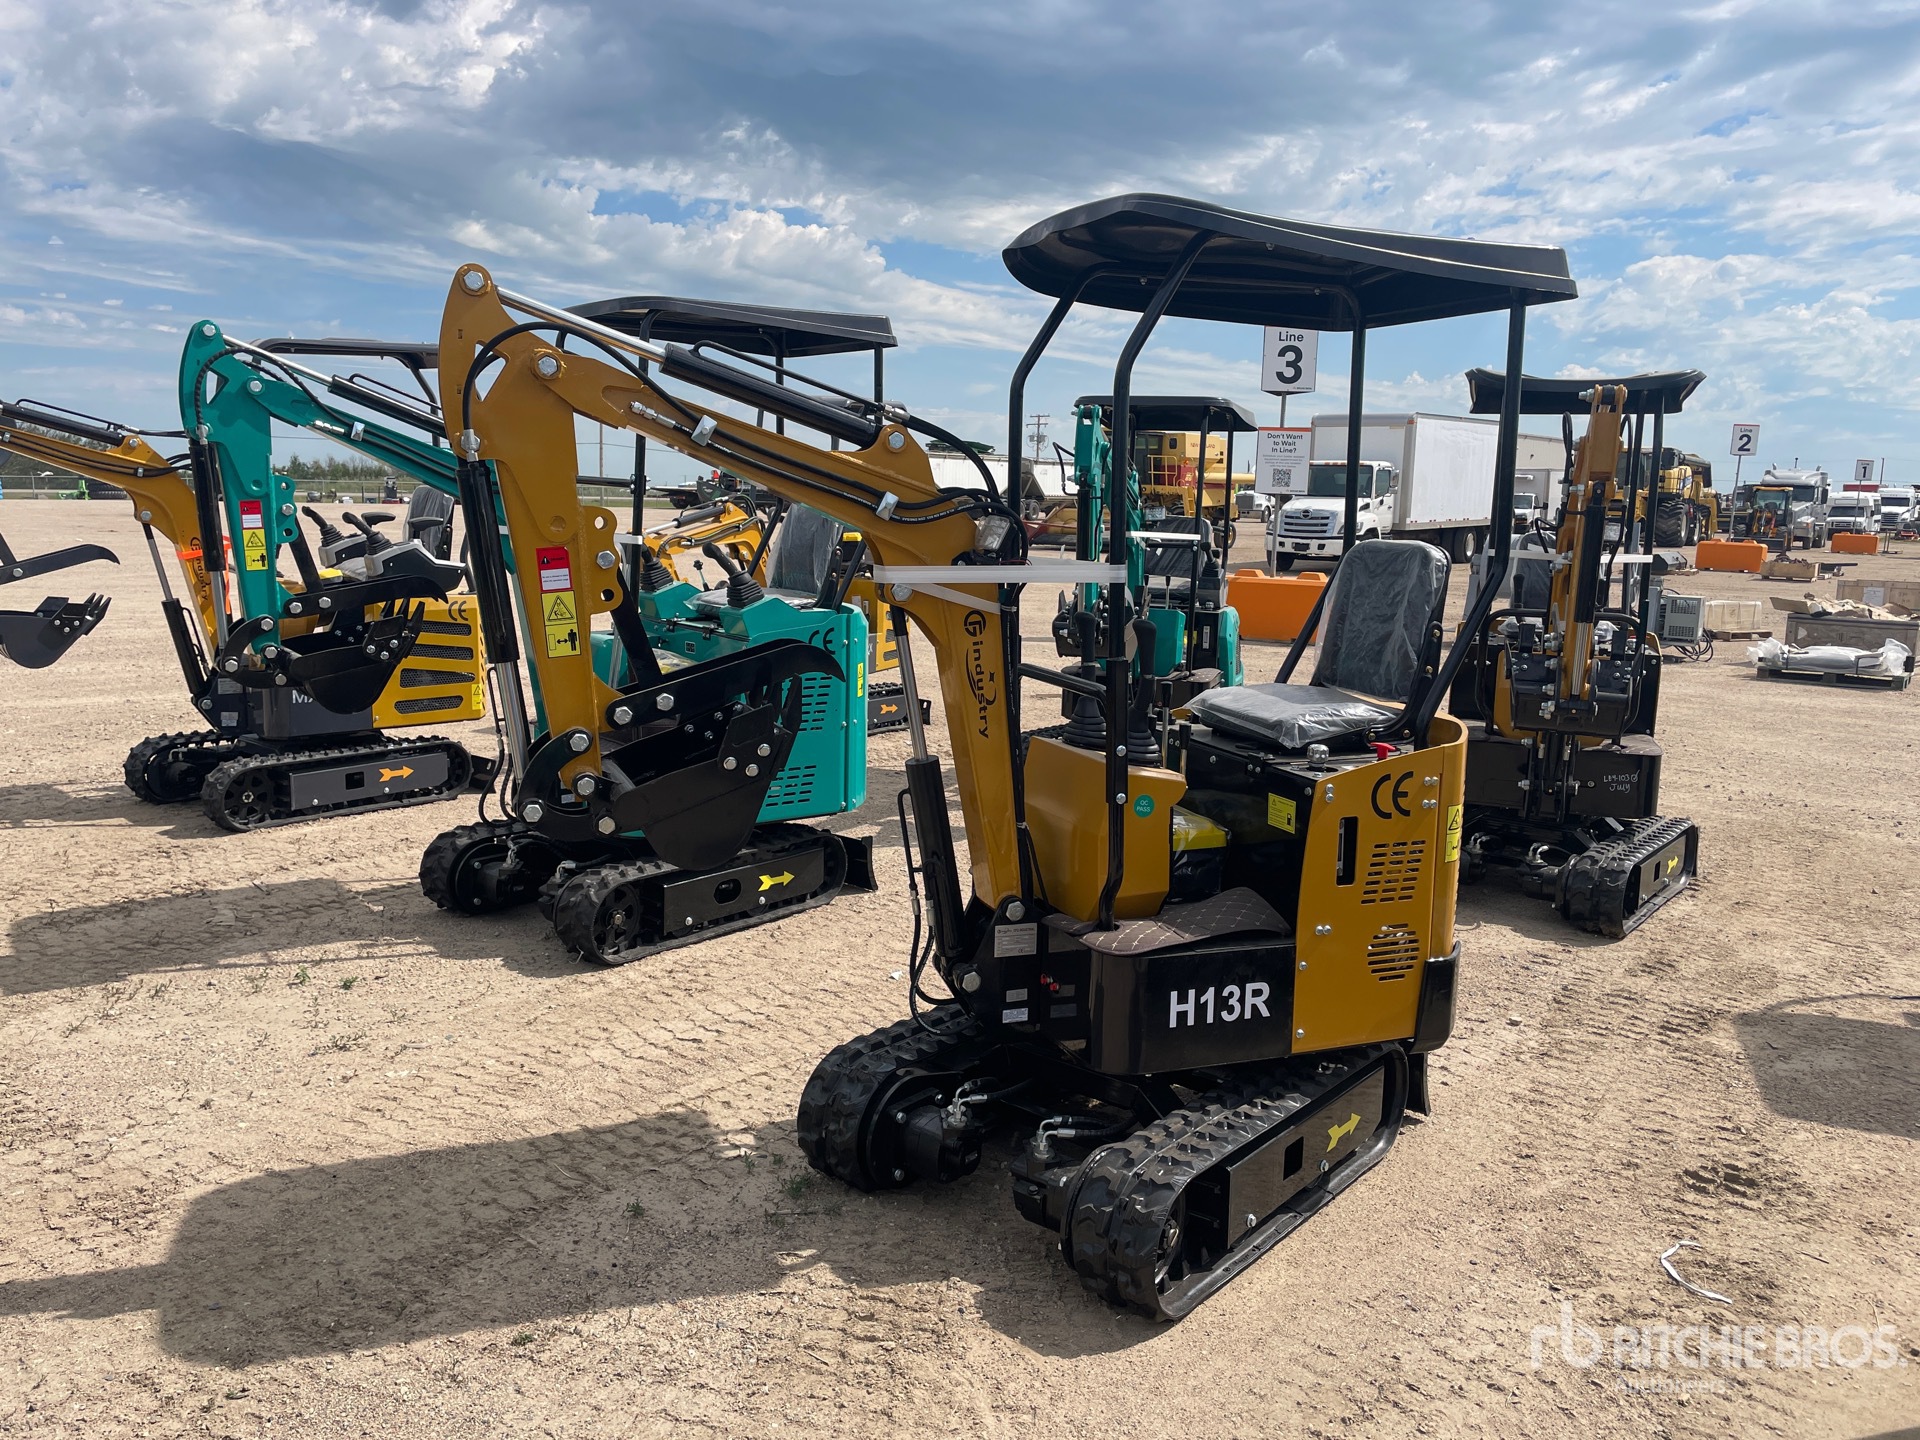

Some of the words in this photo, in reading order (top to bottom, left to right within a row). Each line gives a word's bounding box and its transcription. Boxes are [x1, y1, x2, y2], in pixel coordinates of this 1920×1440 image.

[1278, 331, 1304, 342] Line
[1275, 344, 1303, 385] 3
[1737, 433, 1752, 452] 2
[1861, 466, 1868, 478] 1
[448, 600, 469, 622] CE
[1371, 771, 1414, 820] CE
[1168, 981, 1271, 1029] H13R
